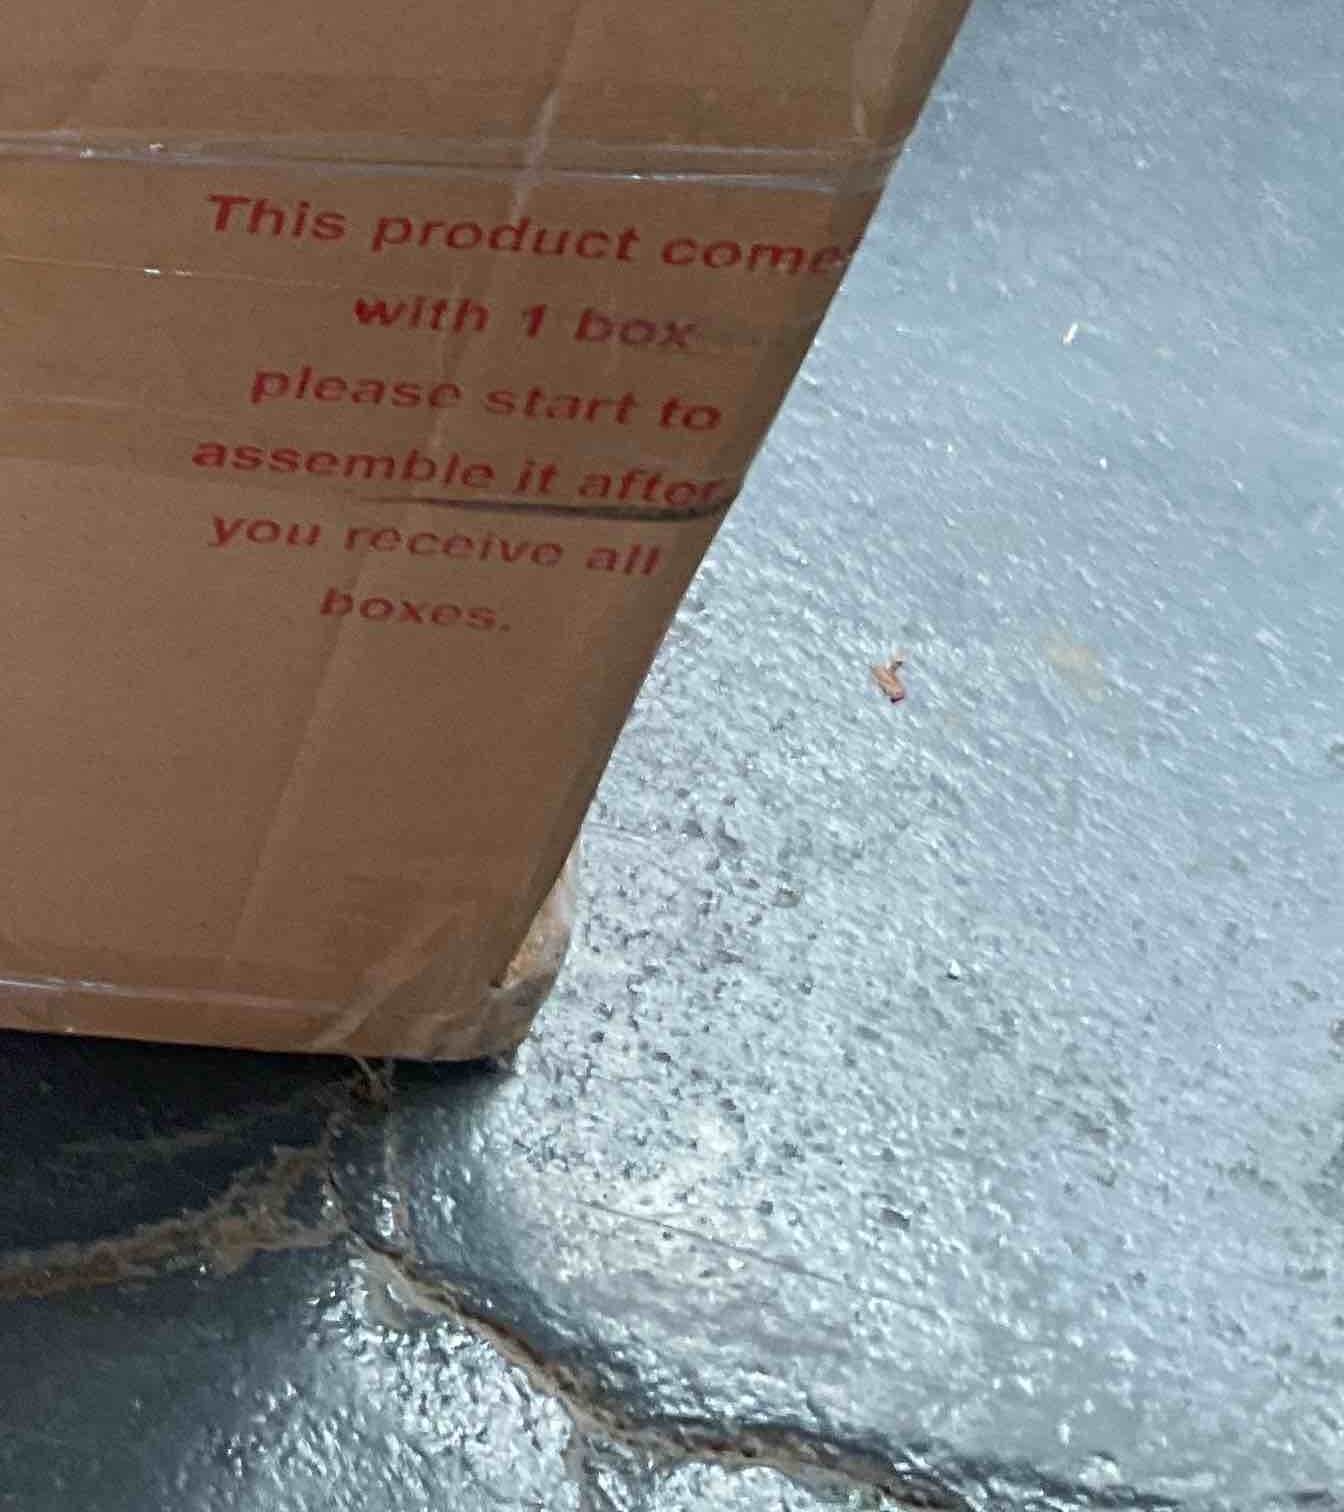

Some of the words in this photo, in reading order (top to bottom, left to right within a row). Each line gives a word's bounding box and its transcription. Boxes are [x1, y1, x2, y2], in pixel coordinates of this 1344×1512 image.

[207, 192, 348, 243] This
[370, 210, 639, 264] product
[354, 292, 490, 334] with
[520, 302, 548, 340] 1
[574, 306, 700, 352] box
[249, 364, 466, 412] please
[480, 382, 640, 428] start
[659, 394, 723, 434] to
[191, 438, 496, 493] assemble
[515, 458, 560, 496] it
[577, 467, 728, 508] after
[207, 513, 322, 551] you
[344, 525, 565, 570] receive
[585, 541, 663, 579] all
[320, 586, 514, 635] boxes.
